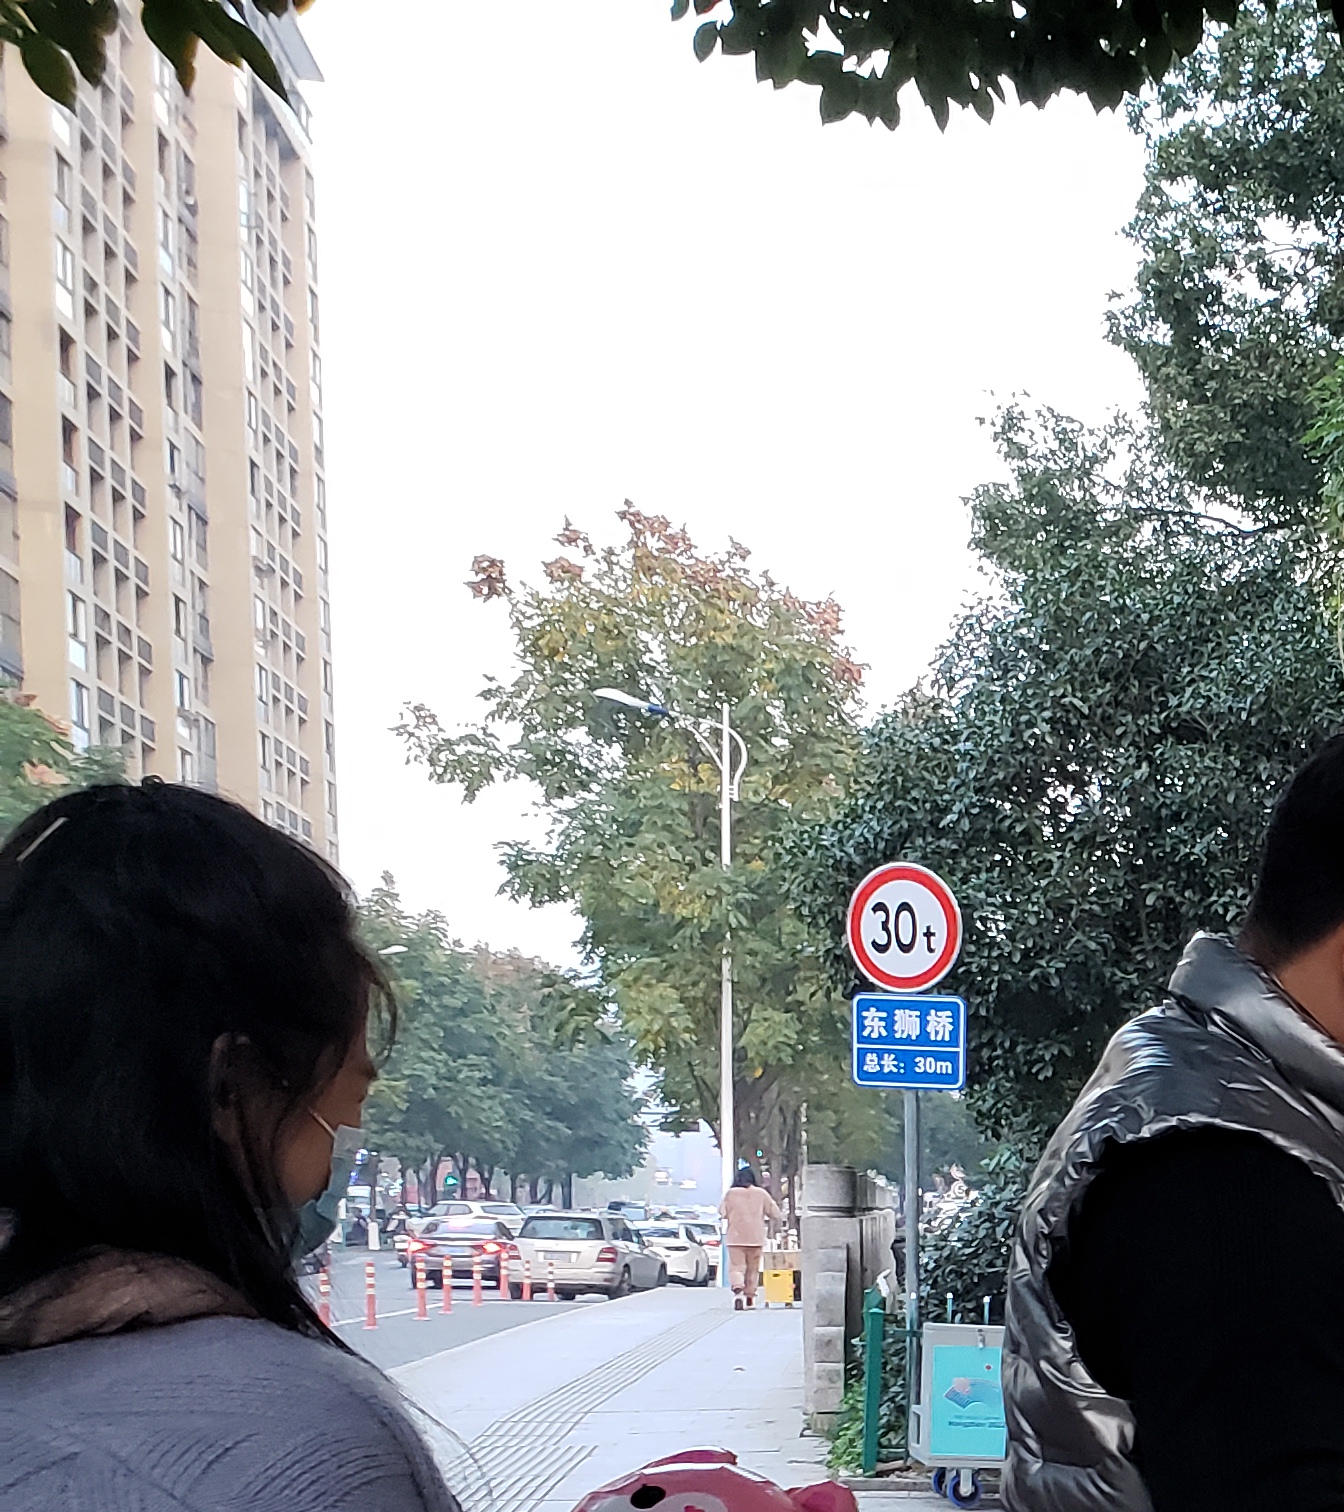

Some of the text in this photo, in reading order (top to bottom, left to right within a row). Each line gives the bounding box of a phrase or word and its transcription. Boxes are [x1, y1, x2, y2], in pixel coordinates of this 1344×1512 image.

[870, 901, 936, 955] 30t
[861, 1006, 954, 1042] 东狮桥
